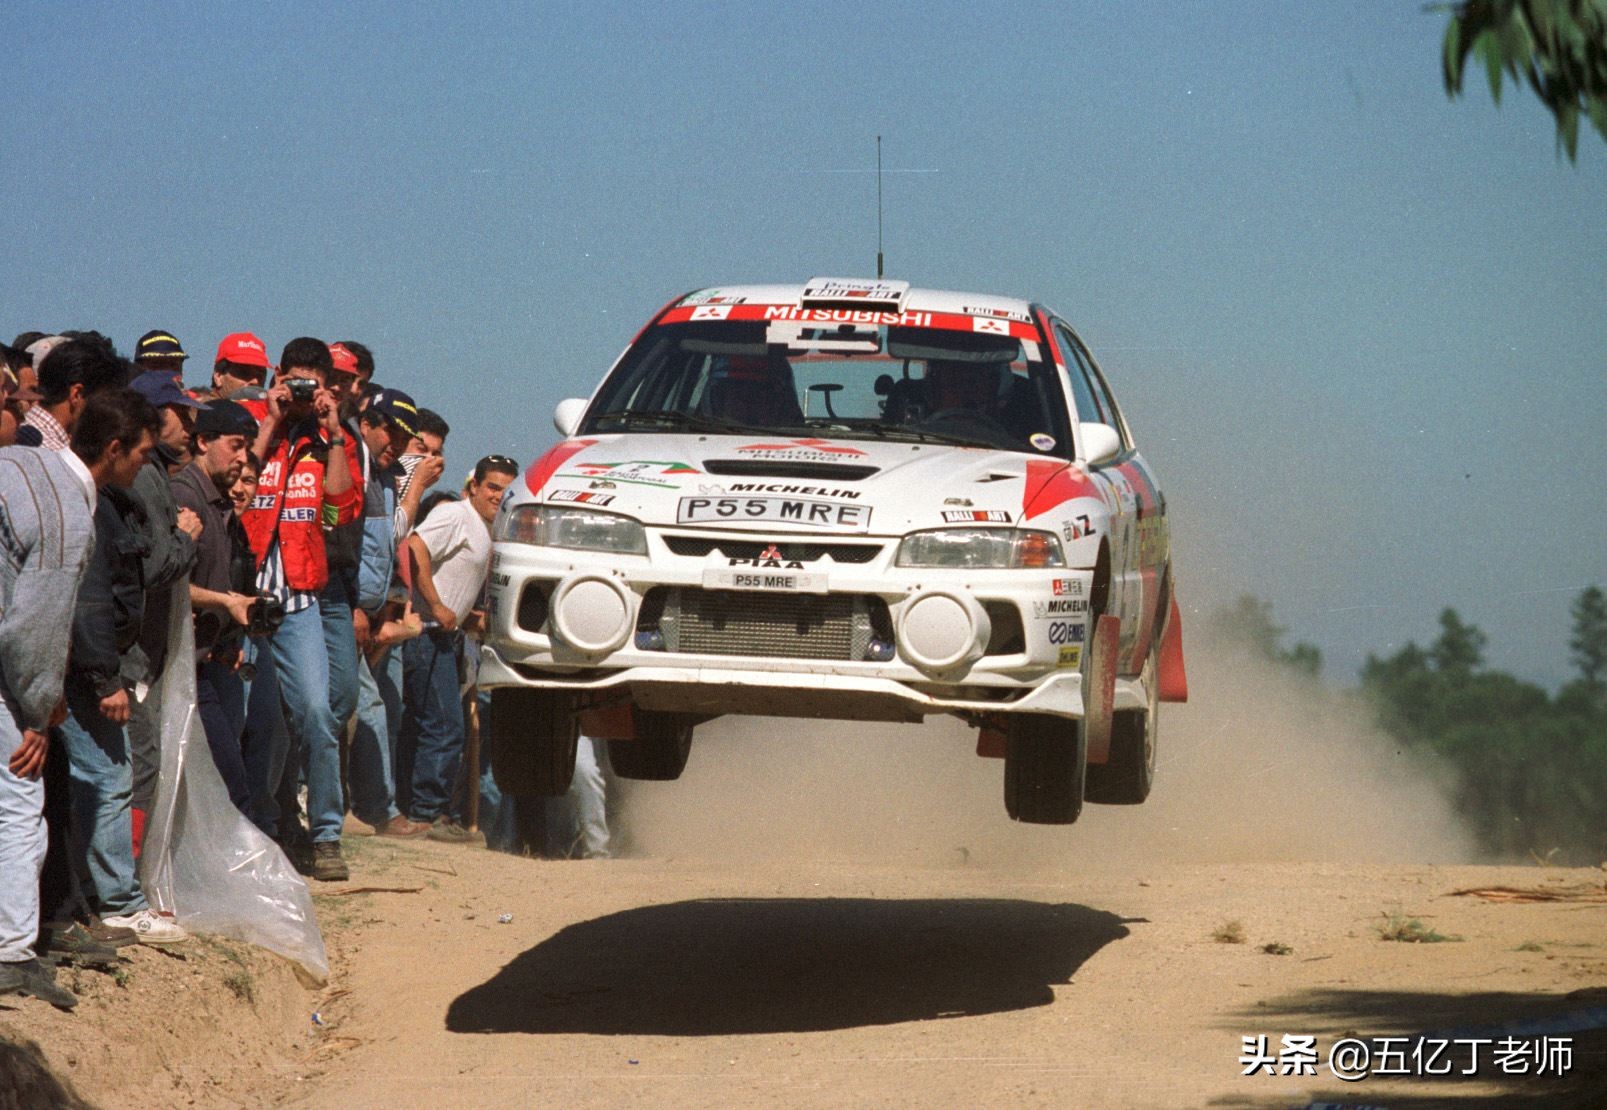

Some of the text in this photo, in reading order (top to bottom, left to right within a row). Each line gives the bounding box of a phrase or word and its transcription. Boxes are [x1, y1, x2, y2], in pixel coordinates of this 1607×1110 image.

[763, 305, 932, 326] MITSUBISHI
[730, 483, 862, 499] MICHELIN
[688, 498, 861, 526] P55 MRE
[728, 558, 805, 570] PIAA
[735, 574, 793, 588] P55 MRE
[1047, 600, 1088, 613] MICHELIN
